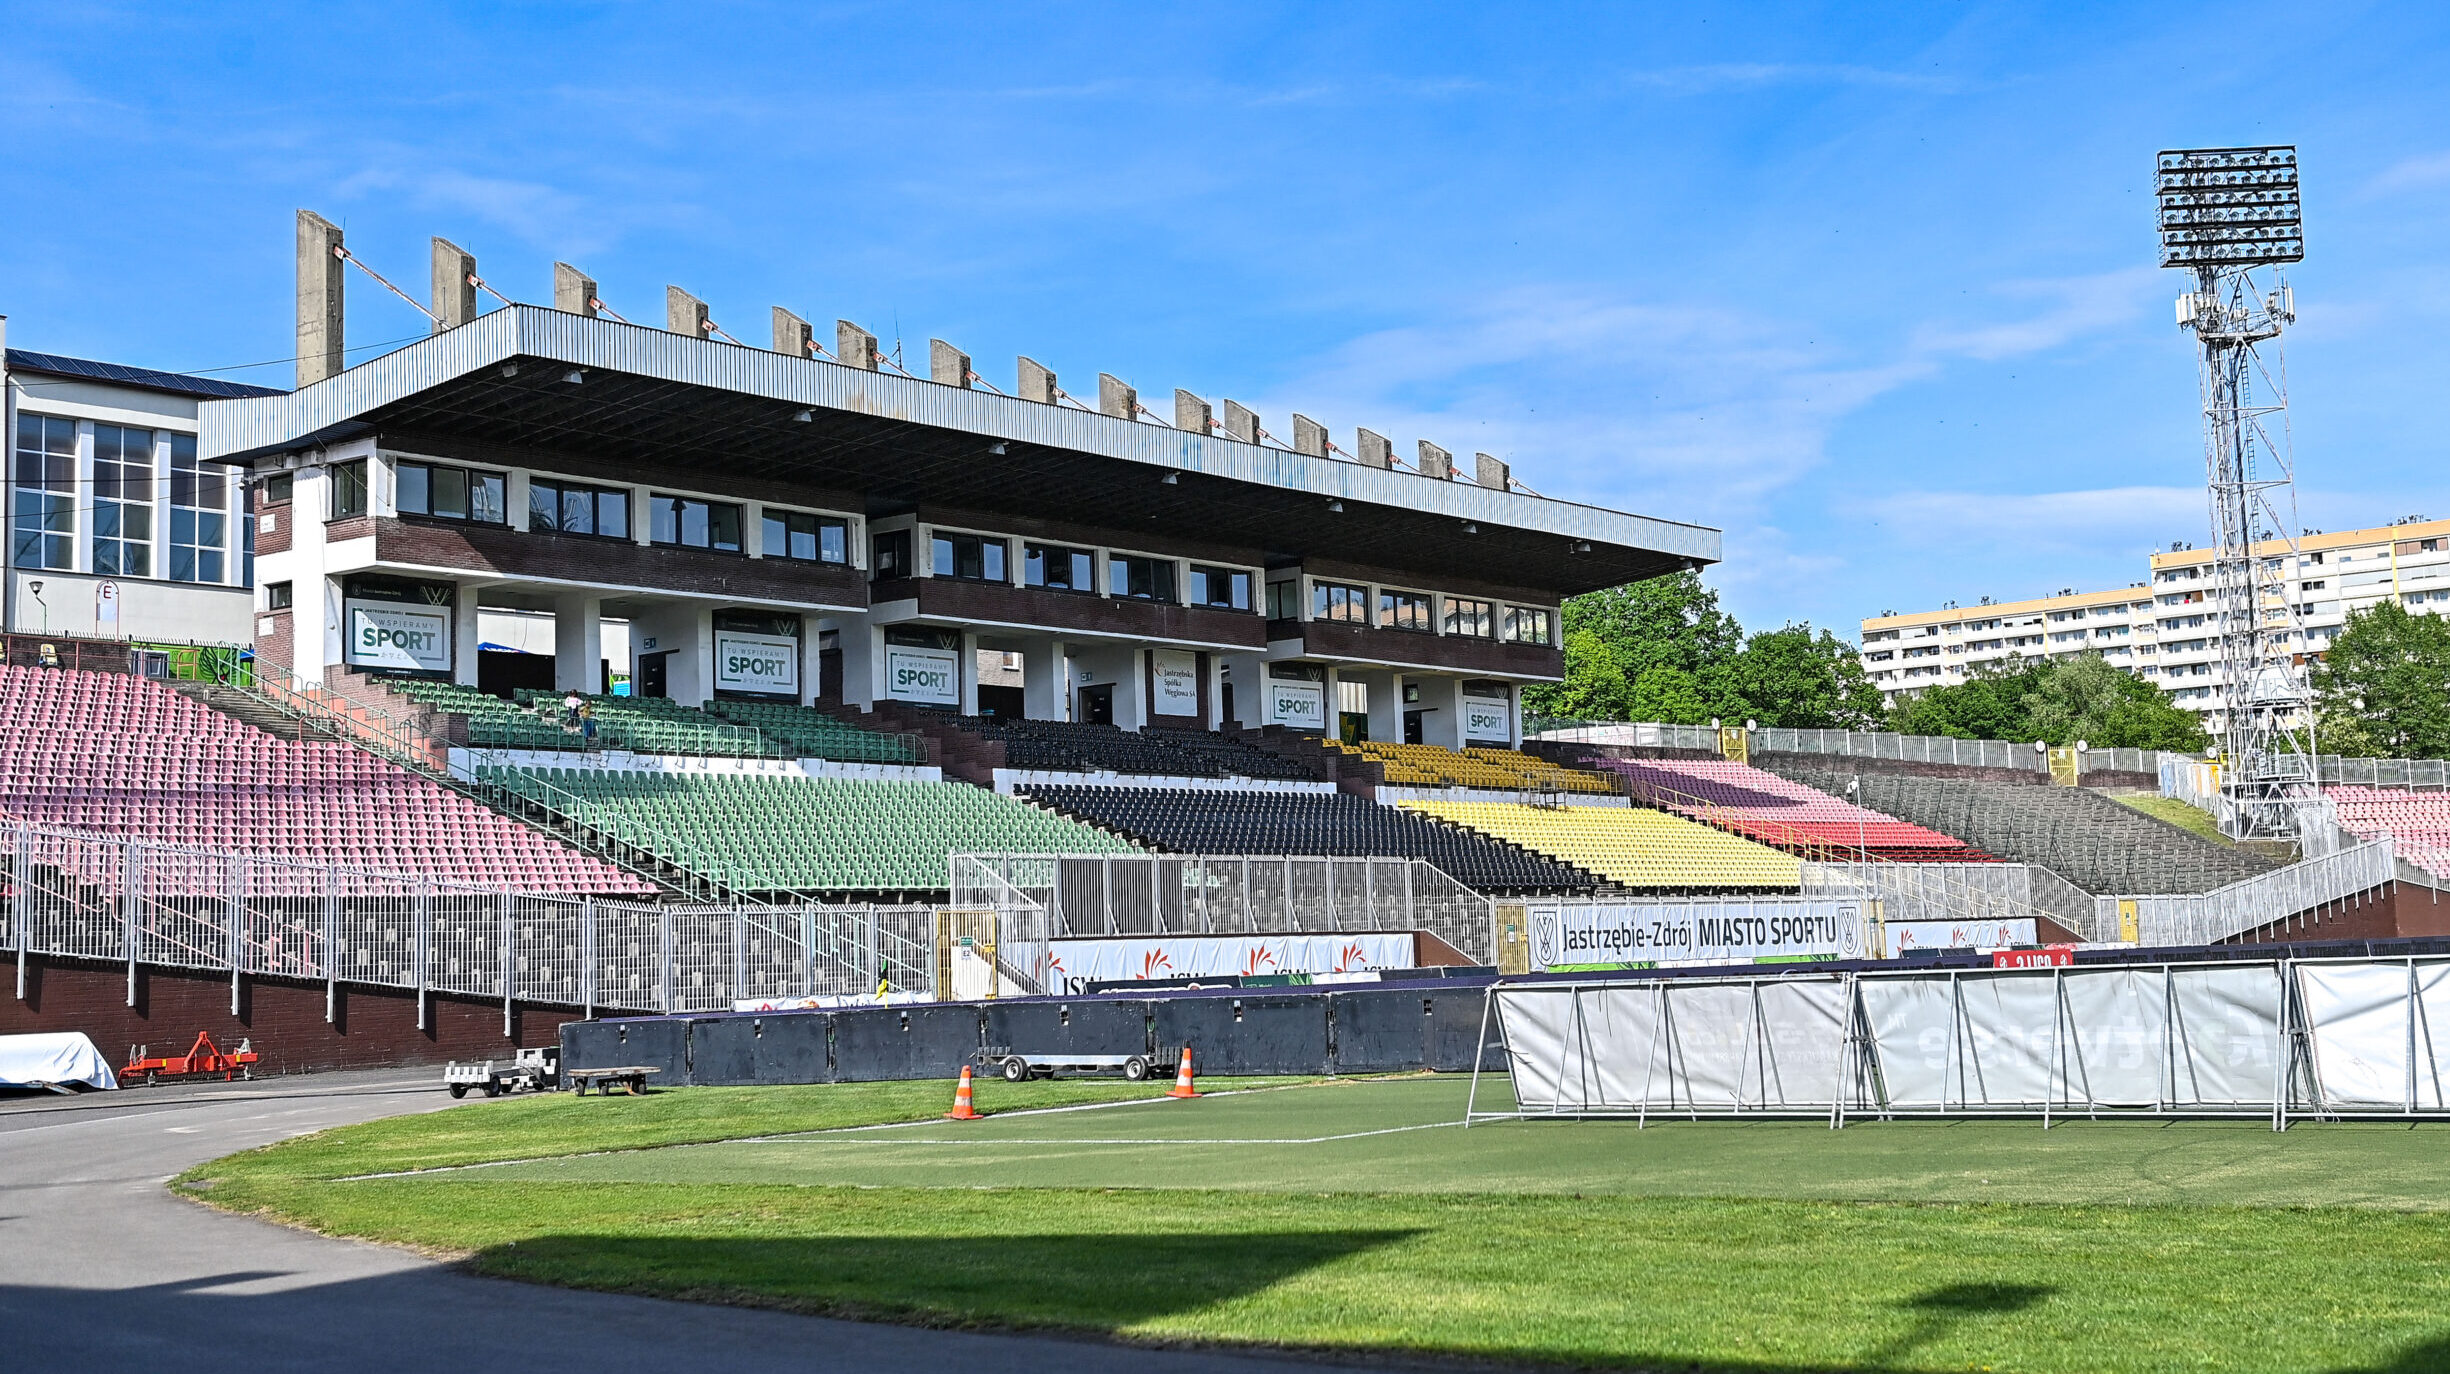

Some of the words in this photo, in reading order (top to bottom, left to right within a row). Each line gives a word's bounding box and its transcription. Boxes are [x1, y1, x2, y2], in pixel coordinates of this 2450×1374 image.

[361, 617, 373, 625] TU
[379, 619, 434, 629] WSPIERAMY
[363, 627, 435, 651] SPORT
[728, 656, 786, 676] SPORT
[897, 668, 948, 688] SPORT
[1164, 678, 1181, 687] Spółka
[1164, 688, 1188, 698] Węglowa
[1278, 698, 1316, 715] SPORT
[1471, 714, 1503, 729] SPORT
[1563, 919, 1692, 955] Jastrzębie-Zdrój
[1699, 917, 1766, 947] MIASTO
[1770, 916, 1837, 945] SPORTU
